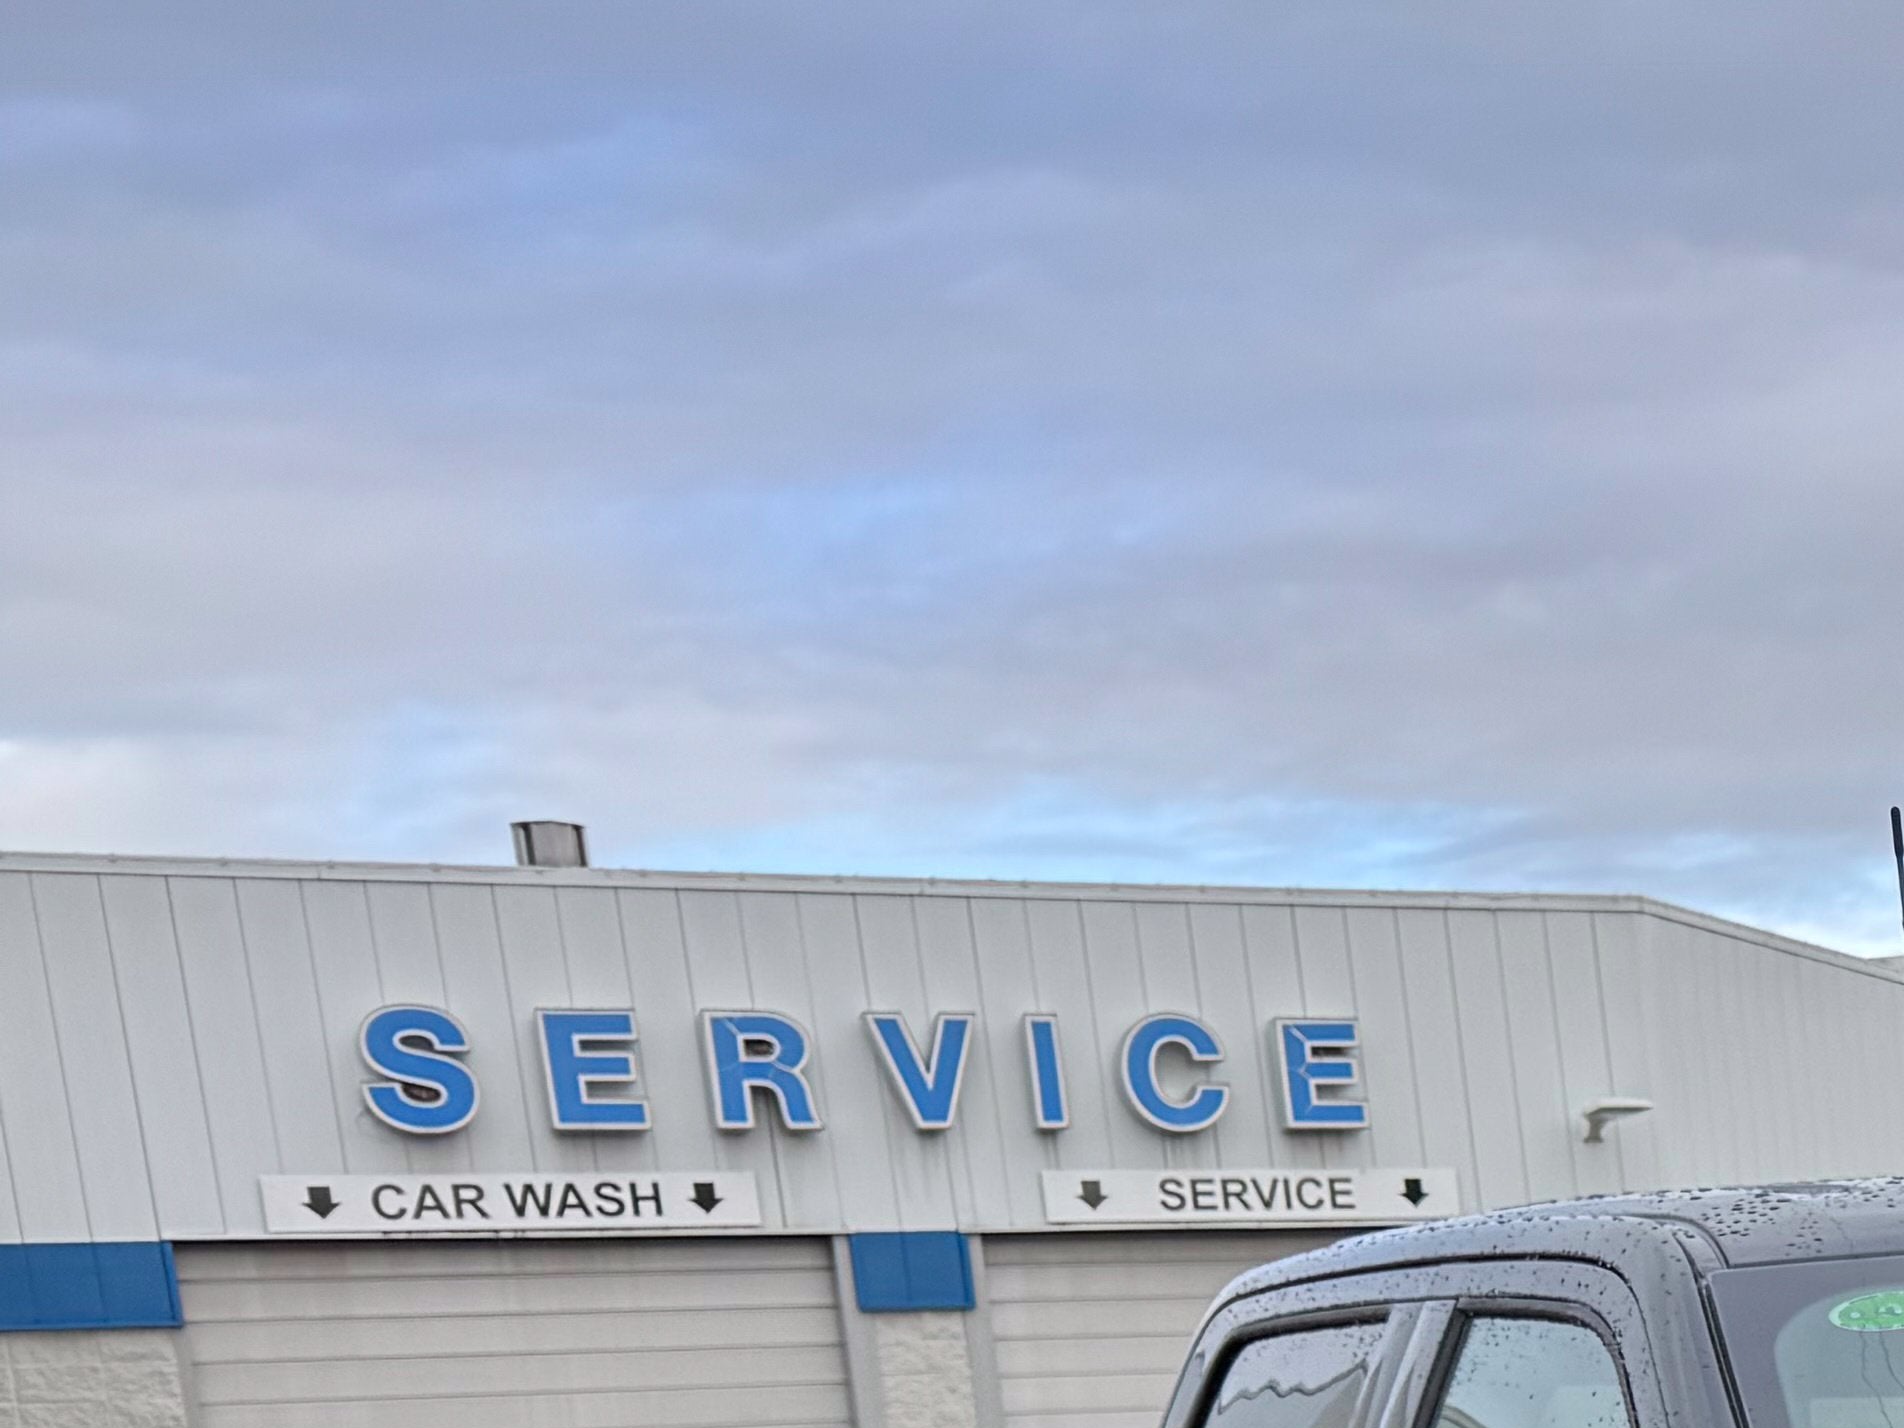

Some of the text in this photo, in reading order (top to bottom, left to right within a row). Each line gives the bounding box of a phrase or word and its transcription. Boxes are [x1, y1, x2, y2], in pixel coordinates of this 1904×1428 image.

[361, 1003, 1370, 1136] SERVICE
[371, 1180, 664, 1221] CAR WASH
[1158, 1175, 1356, 1212] SERVICE
